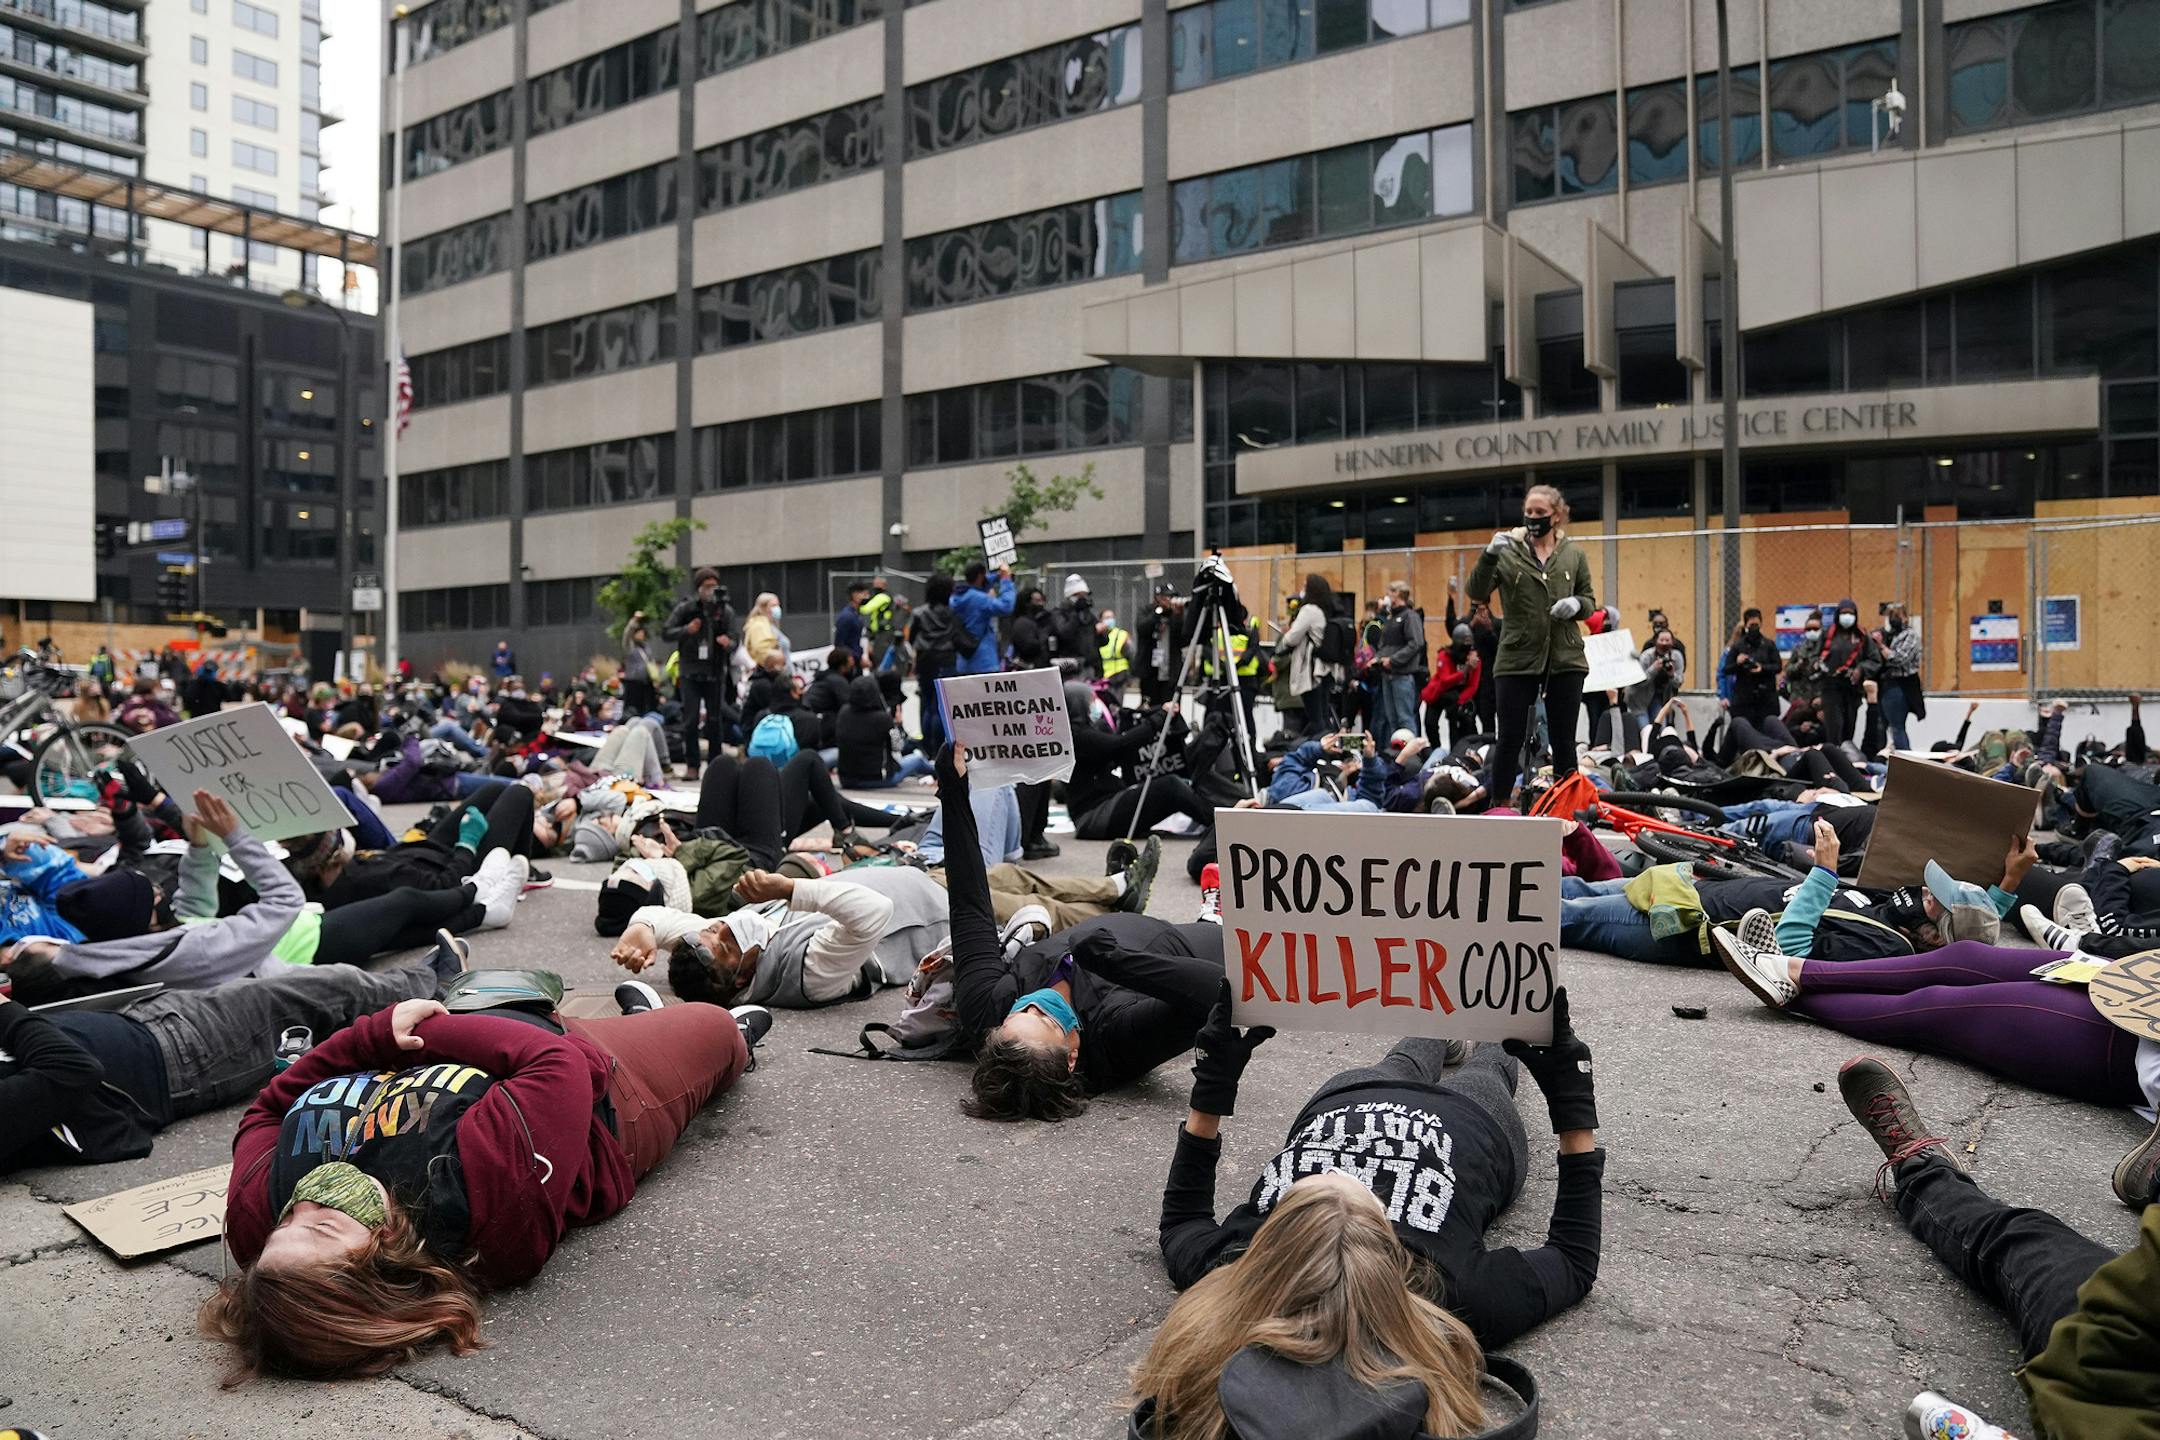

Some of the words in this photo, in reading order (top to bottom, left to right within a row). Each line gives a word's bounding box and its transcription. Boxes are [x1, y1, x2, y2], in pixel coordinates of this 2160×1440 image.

[1334, 440, 1443, 473] HENNEPIN
[1454, 428, 1563, 461] COUNTY
[1575, 419, 1664, 450] FAMILY
[1680, 410, 1788, 444] JUSICE
[1802, 401, 1918, 434] CENTER
[952, 697, 1061, 720] AMERICAN.
[984, 681, 990, 693] I
[994, 680, 1017, 693] AM
[166, 721, 262, 774] JUSTICE
[992, 723, 999, 736] I
[1002, 723, 1027, 736] AM
[220, 771, 254, 794] FOR
[228, 781, 321, 830] LOYD
[1228, 843, 1545, 923] PROSECUTE
[1235, 928, 1456, 1015] KILLER
[1459, 941, 1555, 1015] COPS
[291, 1091, 440, 1157] KNOW
